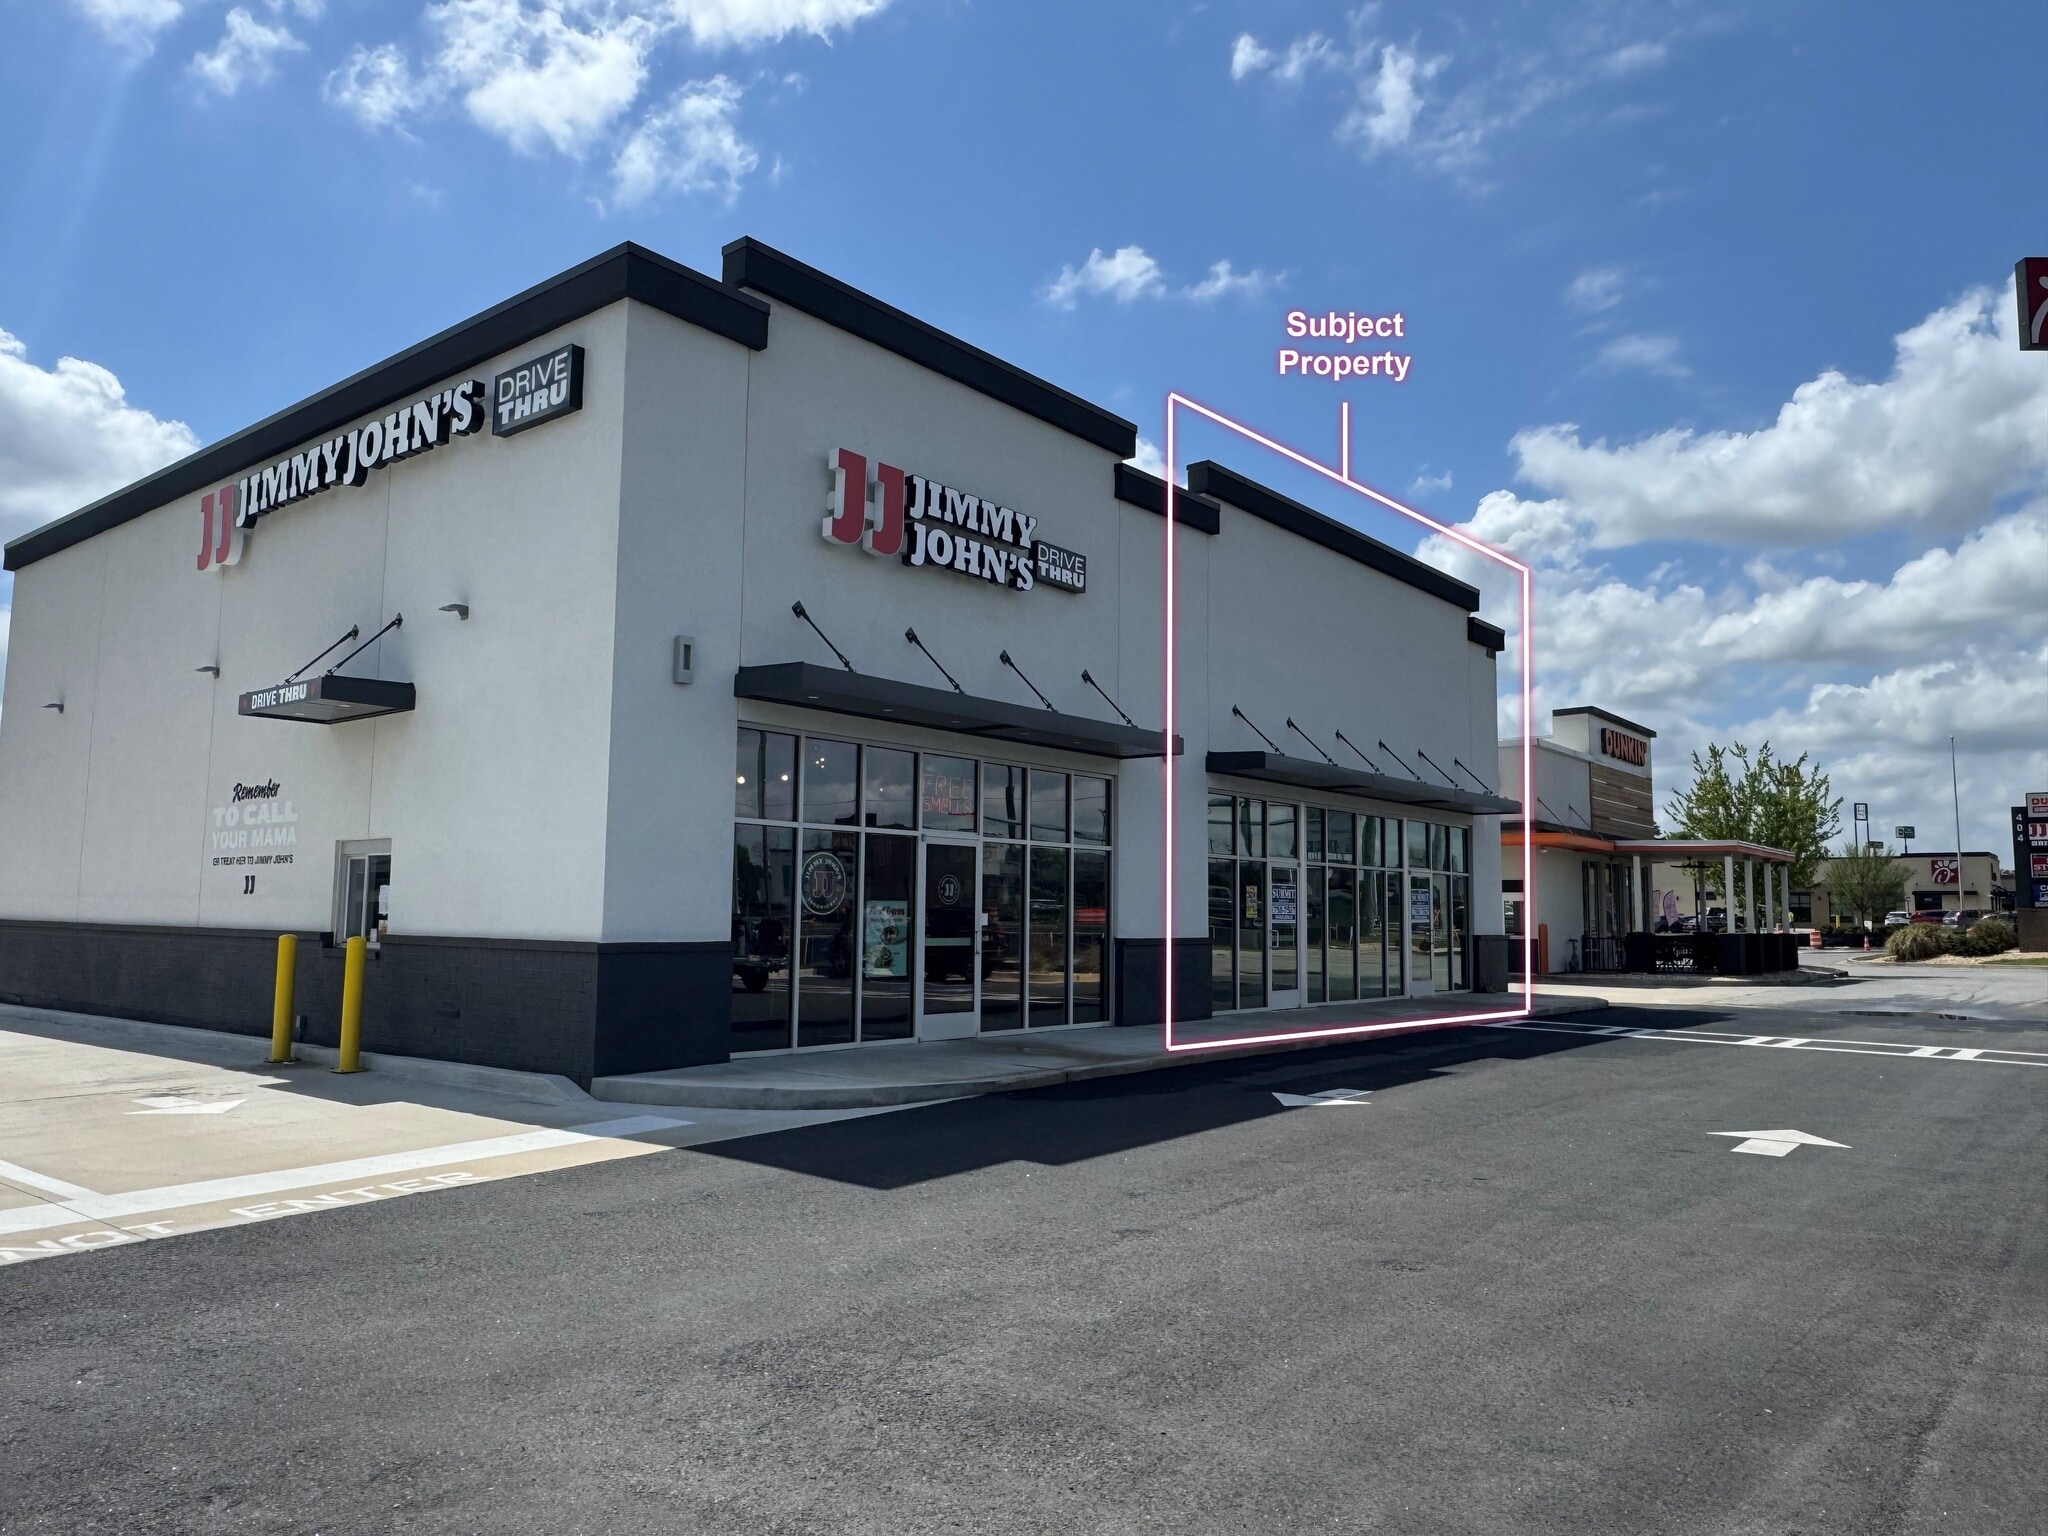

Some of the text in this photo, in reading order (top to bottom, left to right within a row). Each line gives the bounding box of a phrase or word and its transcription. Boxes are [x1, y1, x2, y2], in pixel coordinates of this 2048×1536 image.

[499, 351, 569, 402] DRIVE
[499, 379, 568, 425] THRU
[236, 380, 478, 528] JIMMY JOHN'S
[826, 447, 905, 555] JJ
[908, 475, 1037, 548] JIMMY
[197, 484, 238, 571] JJ
[909, 522, 1034, 591] JOHN'S
[1037, 543, 1085, 574] DRIVE
[1037, 562, 1085, 588] THRU
[251, 683, 308, 710] DRIVE THRU
[232, 778, 281, 804] Remember
[922, 773, 974, 799] FREE
[211, 800, 299, 828] TO CALL
[211, 826, 298, 850] YOUR MAMA
[0, 1171, 489, 1261] NOT ENTER
